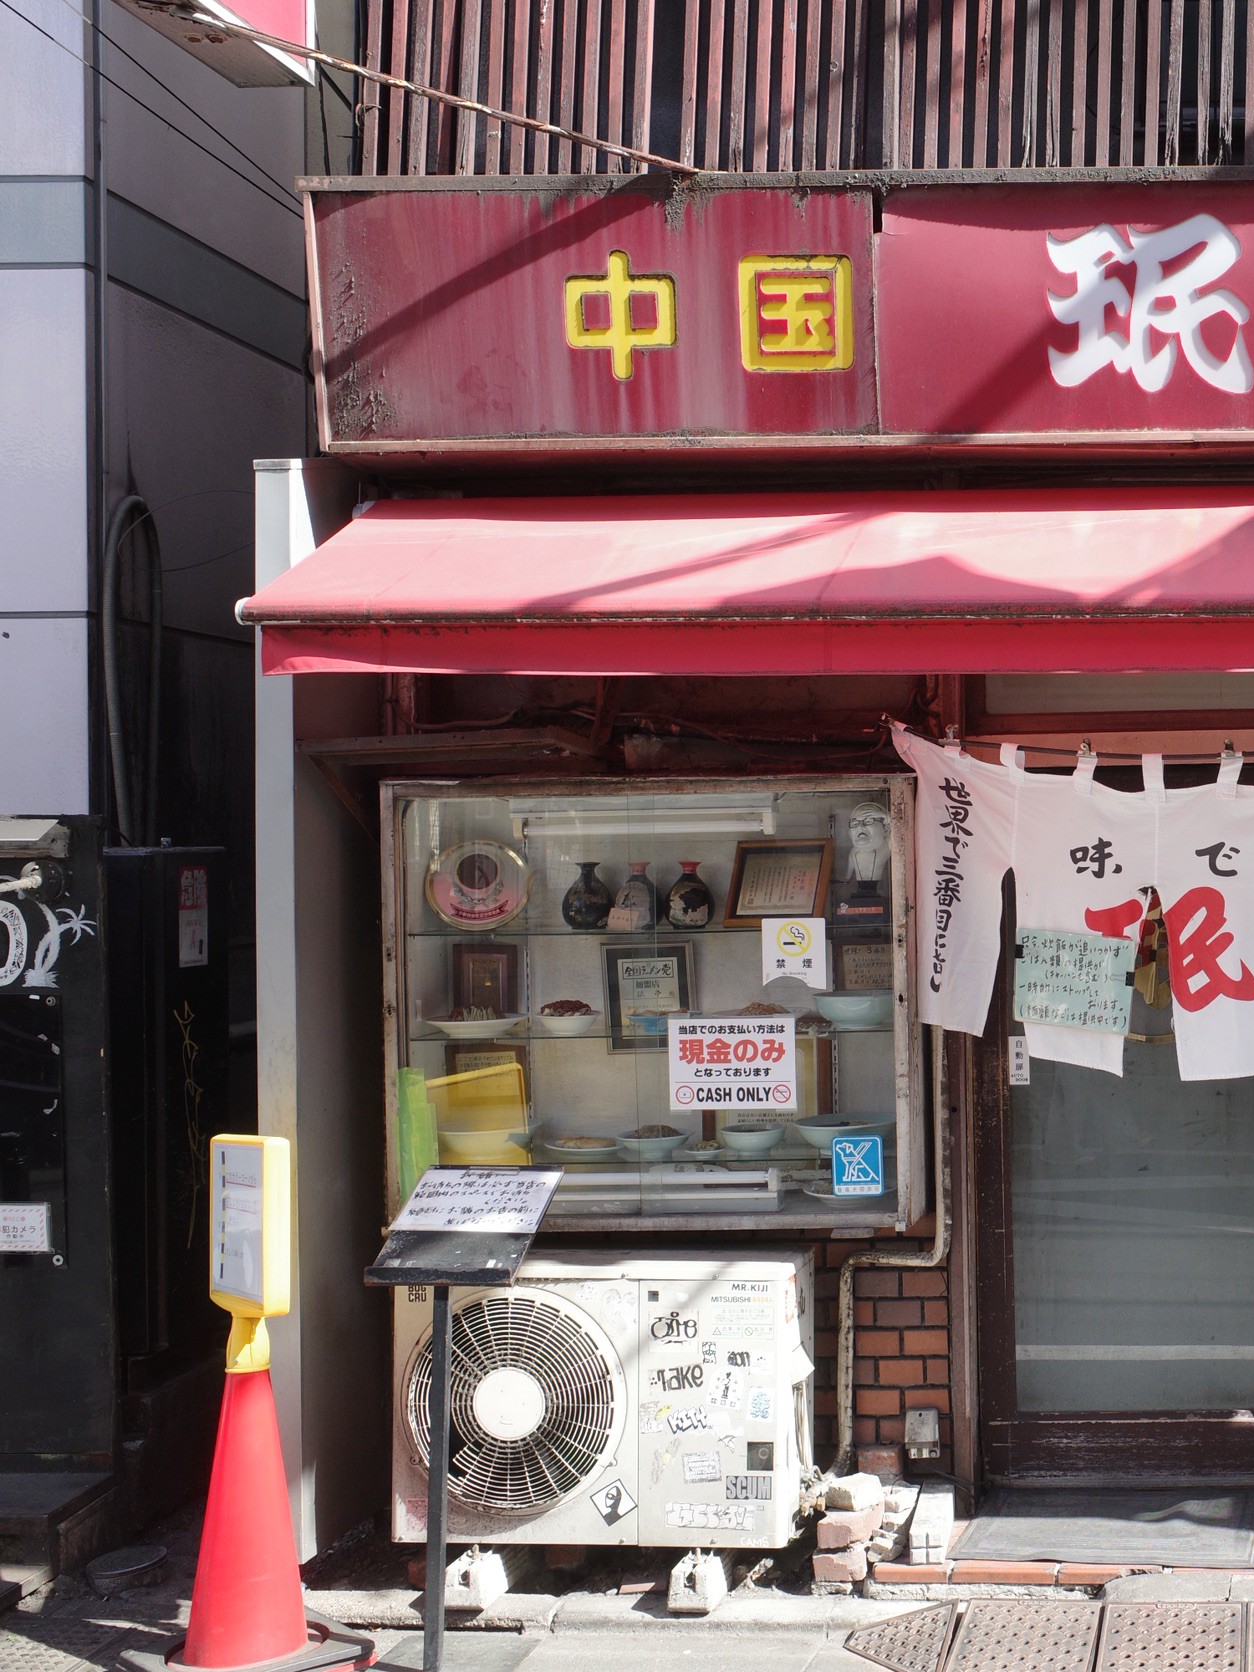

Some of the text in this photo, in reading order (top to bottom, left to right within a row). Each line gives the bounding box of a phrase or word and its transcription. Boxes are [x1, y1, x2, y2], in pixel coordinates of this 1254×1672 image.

[563, 248, 855, 382] 中国
[776, 958, 812, 969] 禁煙
[679, 1025, 785, 1035] 当店でのお支払い方法は
[679, 1038, 786, 1065] 現金のみ
[694, 1068, 772, 1077] となっております
[696, 1087, 772, 1102] CASH ONLY
[0, 1225, 37, 1234] 犯カメラ
[731, 1283, 769, 1293] MR.KIJI
[408, 1292, 427, 1303] CRU
[727, 1477, 772, 1499] SCUM
